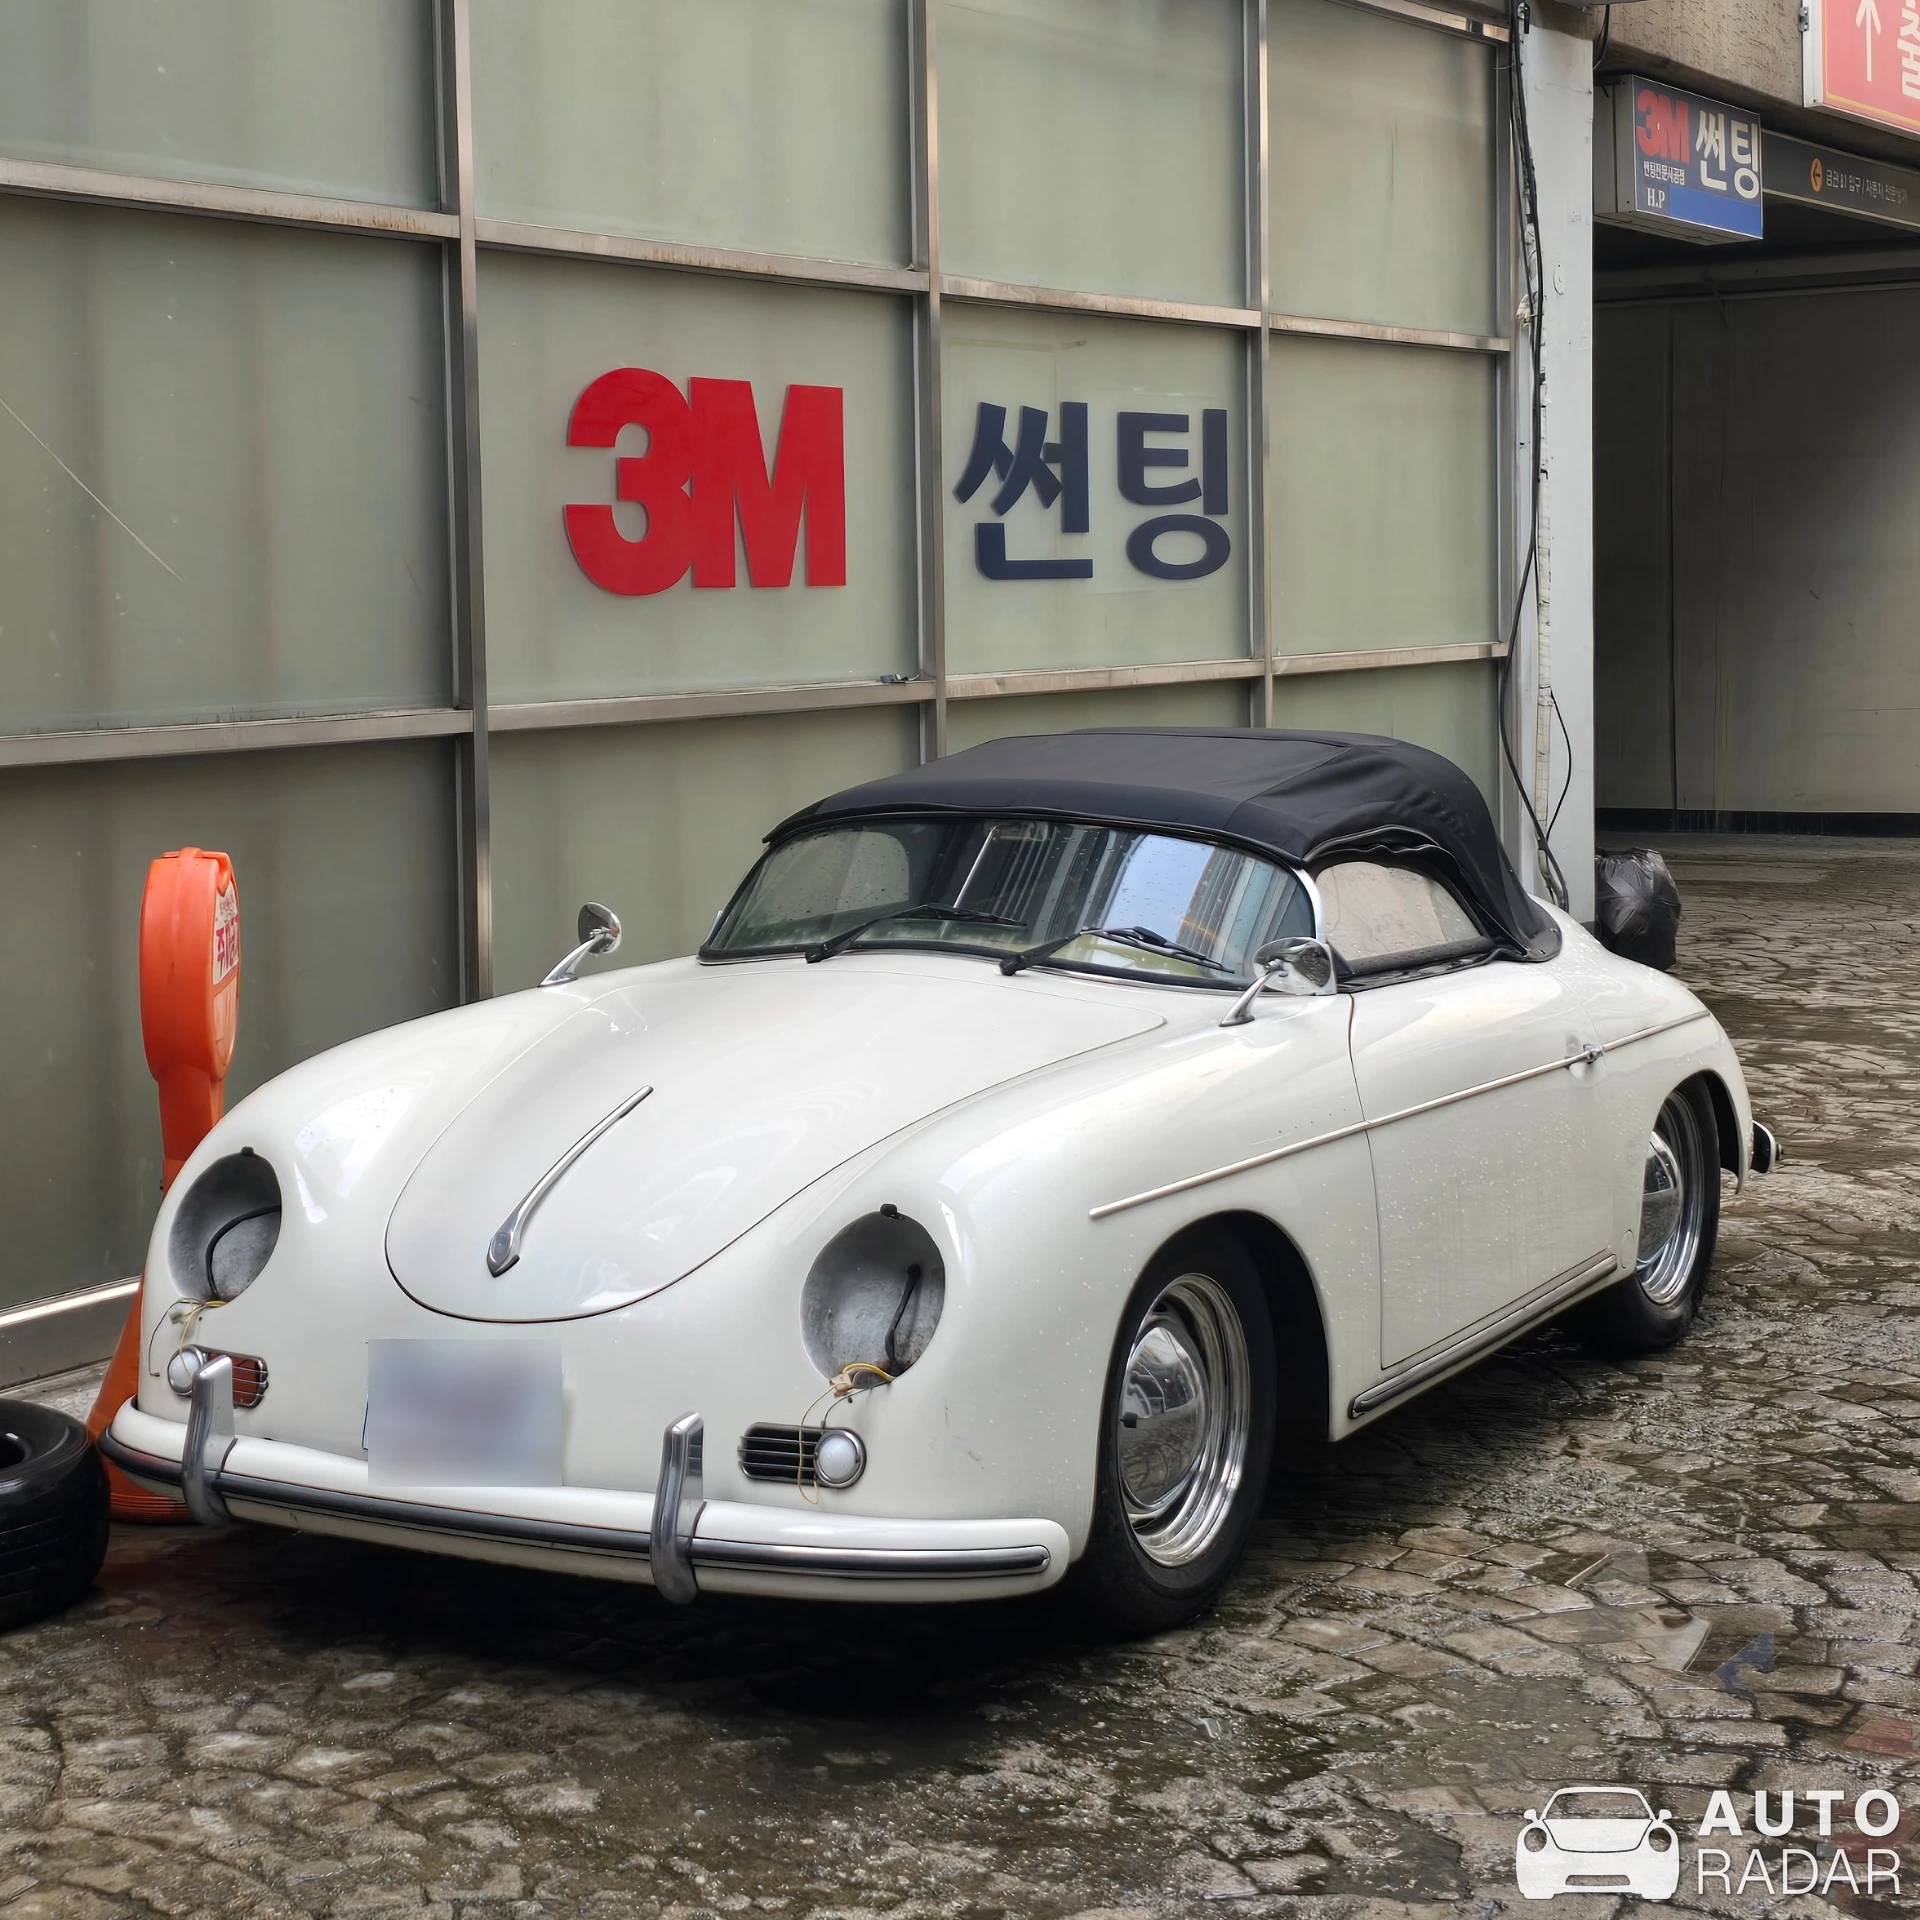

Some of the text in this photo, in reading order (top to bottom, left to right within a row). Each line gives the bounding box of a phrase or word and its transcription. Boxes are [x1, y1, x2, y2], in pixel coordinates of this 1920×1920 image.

[1636, 89, 1759, 199] 3M 썬팅
[1647, 188, 1665, 208] H.P
[562, 367, 1231, 596] 3M 썬팅
